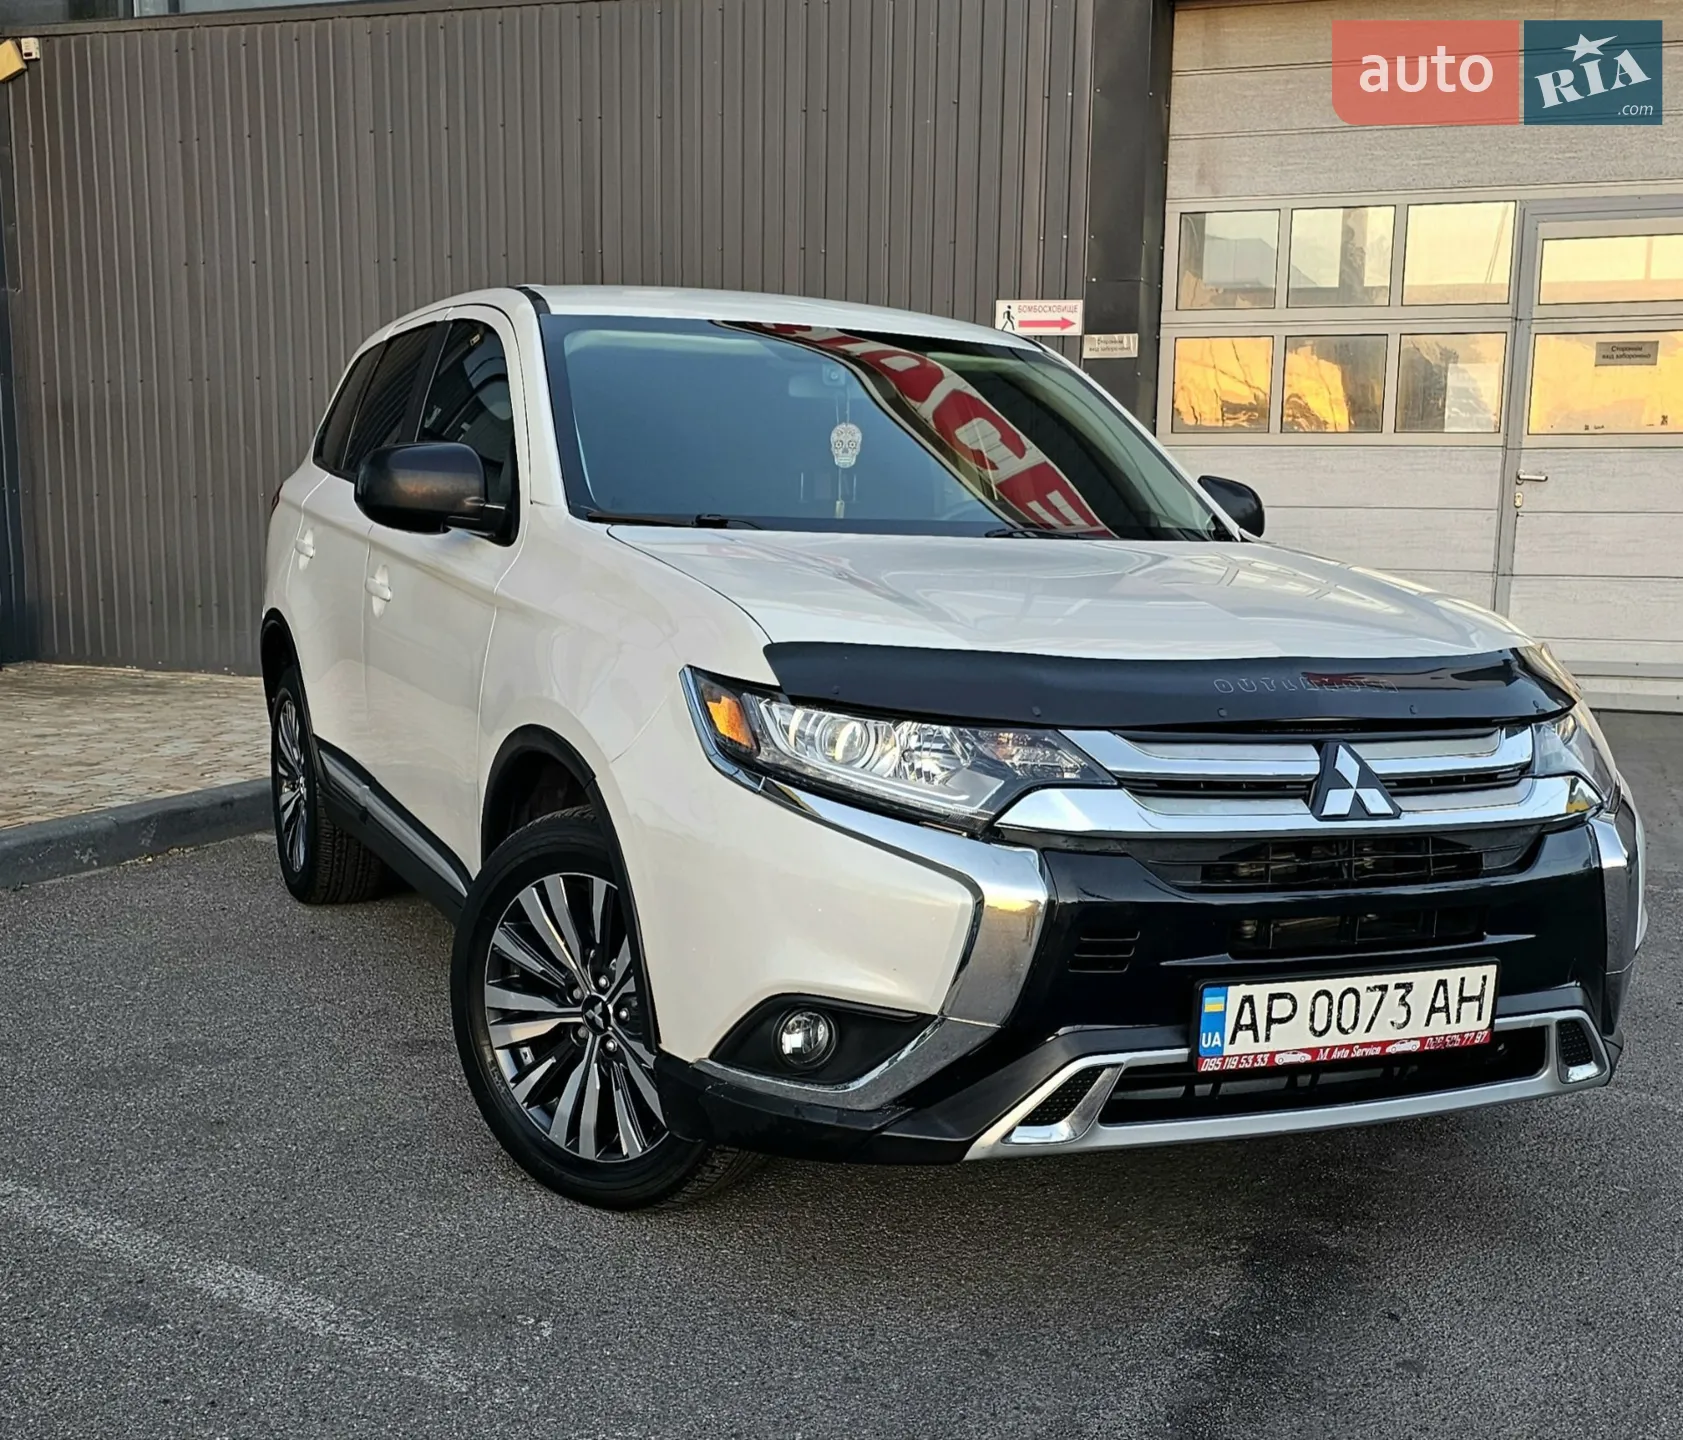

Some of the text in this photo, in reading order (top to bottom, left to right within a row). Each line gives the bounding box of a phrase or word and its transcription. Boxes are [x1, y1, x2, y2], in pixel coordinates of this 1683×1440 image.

[1017, 304, 1079, 314] БОМБОСХОВИЩЕ
[1229, 974, 1488, 1045] AP 0073 AH
[1201, 1035, 1222, 1048] UA
[1351, 1044, 1381, 1057] Service
